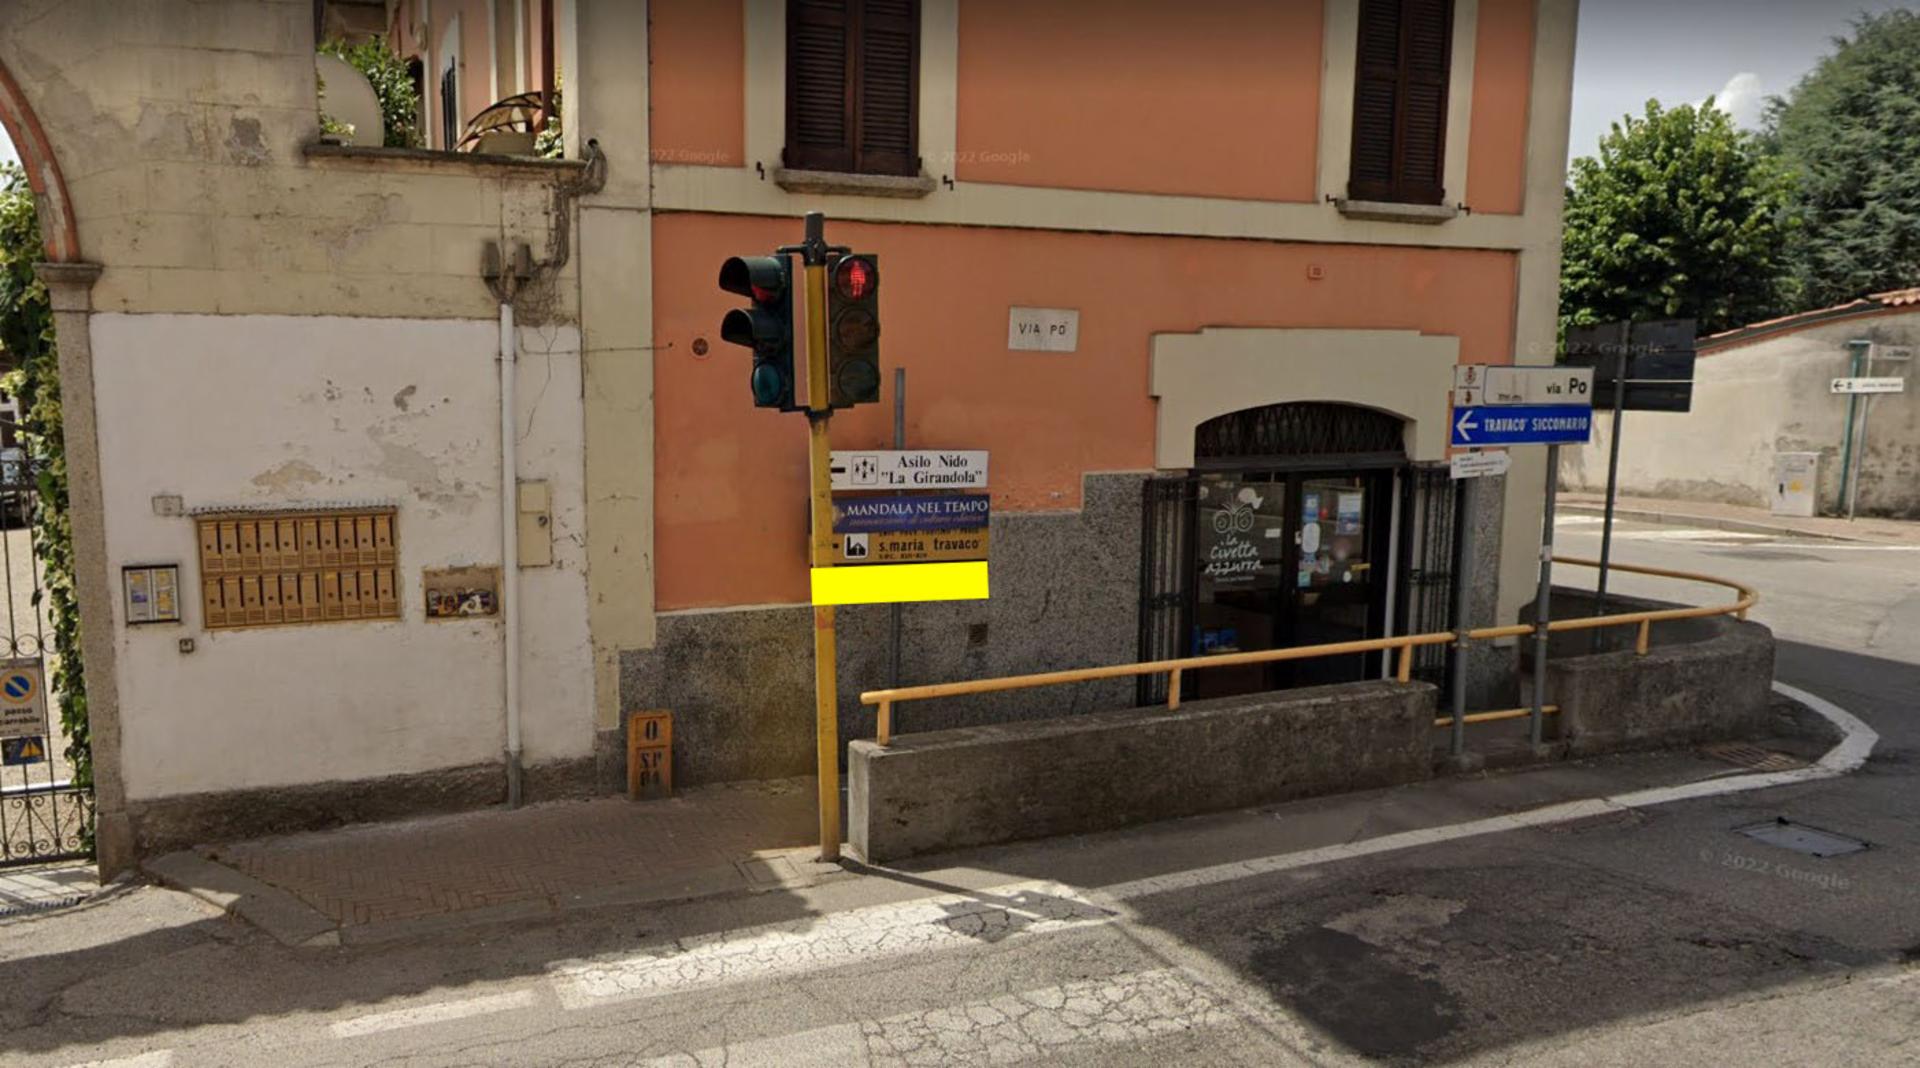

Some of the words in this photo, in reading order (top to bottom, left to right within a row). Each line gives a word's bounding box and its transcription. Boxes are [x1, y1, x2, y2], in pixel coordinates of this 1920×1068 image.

[1018, 322, 1041, 335] VIA
[1546, 383, 1561, 394] via
[1568, 377, 1587, 394] Po
[1532, 416, 1588, 432] SICCOMARIO
[898, 455, 931, 468] Asilo
[939, 454, 968, 468] Nido
[847, 503, 913, 516] MANDALA
[917, 502, 941, 514] NEL
[945, 500, 988, 513] TEMPO
